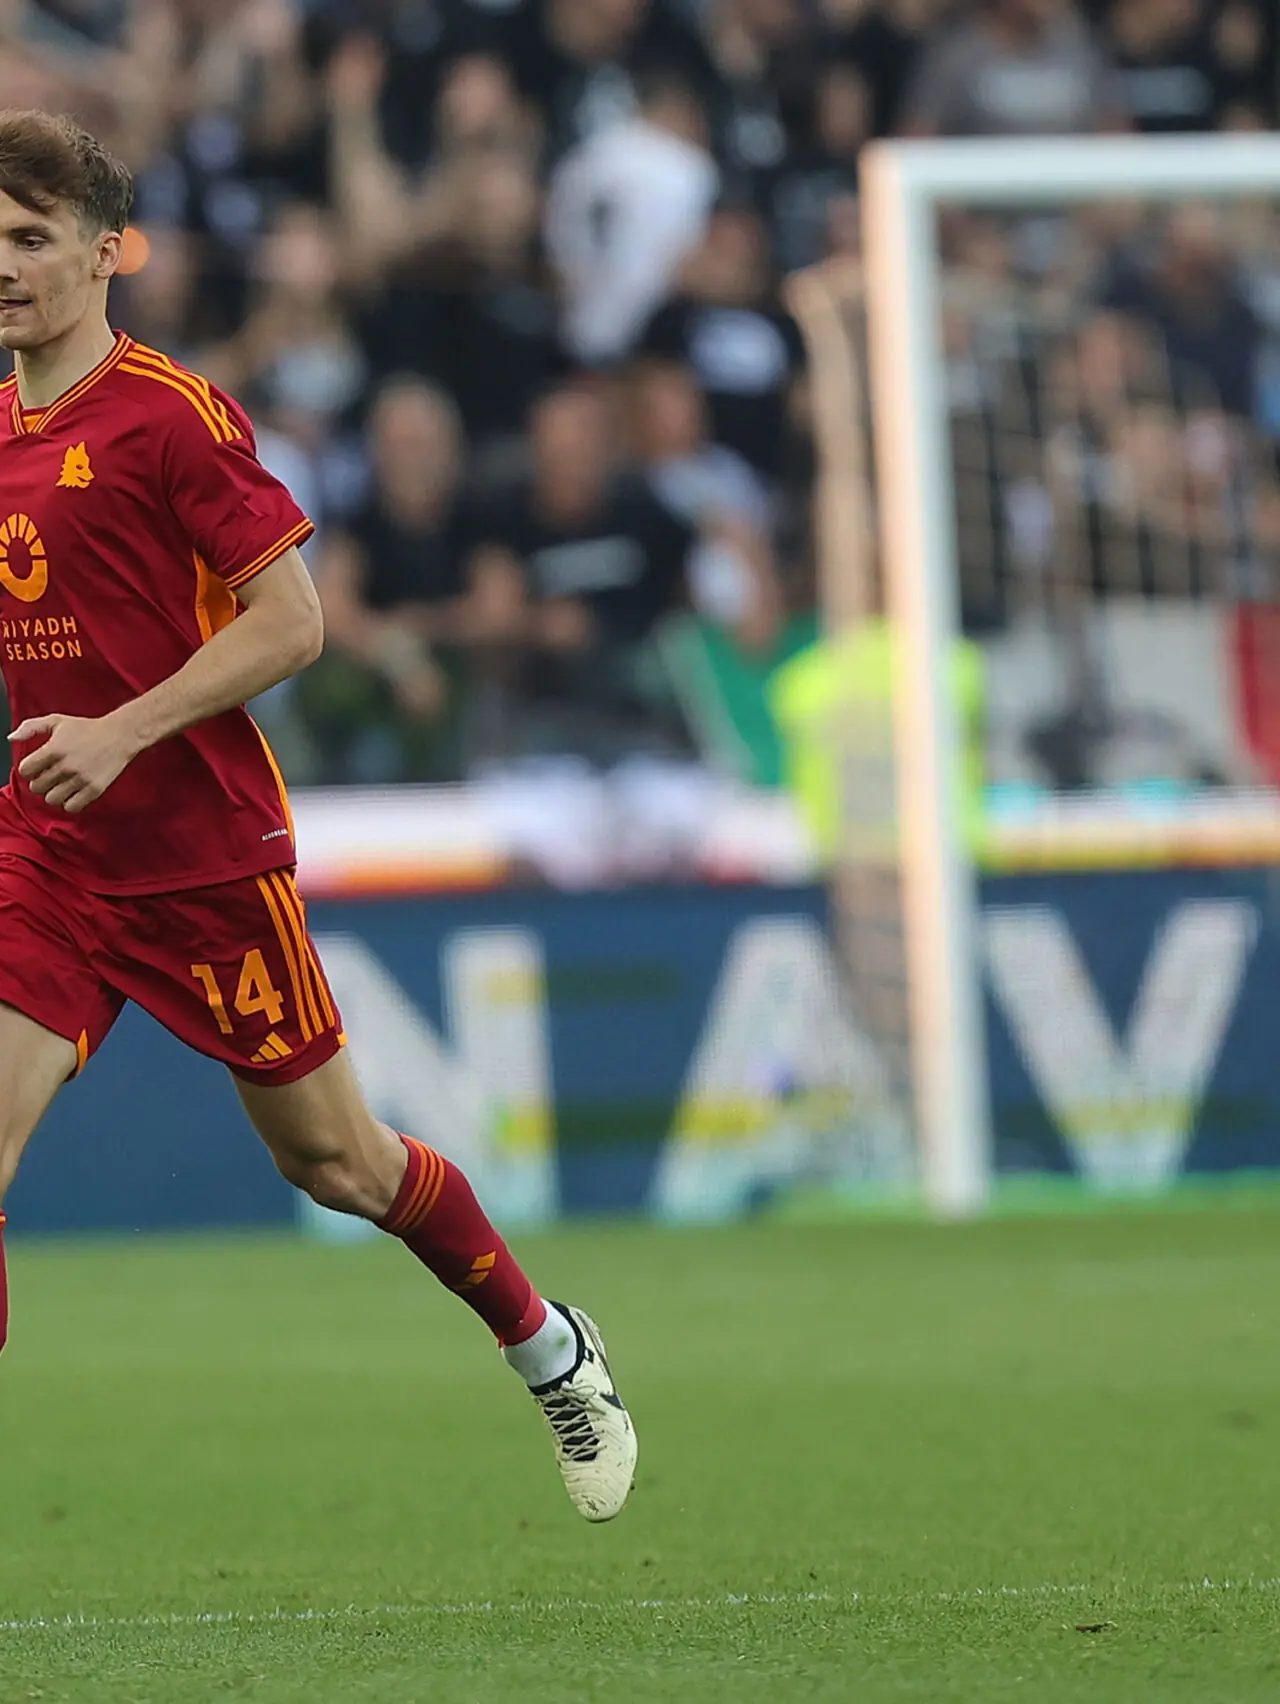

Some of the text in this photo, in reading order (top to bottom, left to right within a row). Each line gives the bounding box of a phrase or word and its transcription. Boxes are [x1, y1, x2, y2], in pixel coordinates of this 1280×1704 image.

[1, 616, 78, 639] RIYADH
[5, 639, 82, 661] SEASON
[190, 948, 284, 1035] 14
[297, 896, 1261, 1241] NAV
